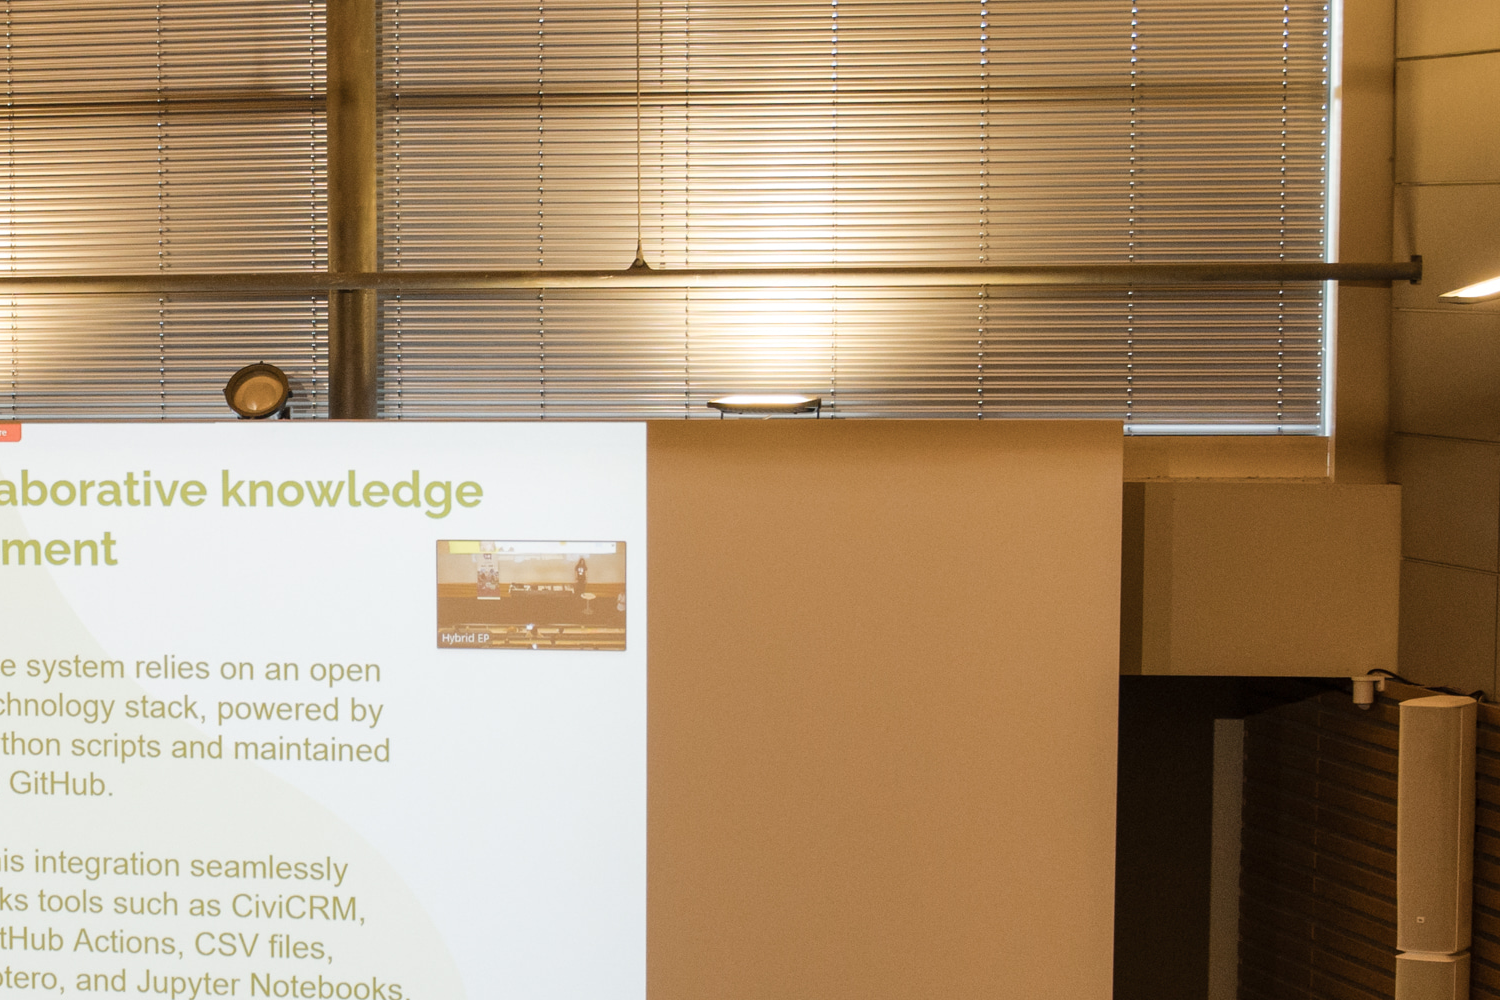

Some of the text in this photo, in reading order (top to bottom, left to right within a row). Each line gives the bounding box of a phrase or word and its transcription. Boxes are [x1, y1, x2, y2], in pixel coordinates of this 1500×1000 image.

[221, 469, 484, 520] knowledge
[442, 632, 490, 646] Hybrid EP
[26, 654, 125, 684] system
[135, 654, 210, 680] relies
[220, 661, 254, 680] on
[264, 662, 299, 681] an
[309, 662, 381, 688] open
[125, 694, 205, 723] stack,
[218, 696, 339, 726] powered
[350, 697, 384, 729] by
[71, 734, 161, 764] scripts
[171, 734, 223, 759] and
[234, 737, 390, 763] maintained
[9, 770, 113, 796] GitHub.
[35, 850, 180, 881] integration
[190, 854, 348, 888] seamlessly
[38, 889, 103, 914] tools
[113, 891, 178, 916] such
[188, 898, 221, 917] as
[231, 893, 365, 926] CiviCRM,
[73, 927, 183, 959] Actions,
[194, 931, 259, 958] CSV
[268, 933, 333, 964] files,
[76, 968, 126, 992] and
[136, 969, 241, 1000] Jupyter
